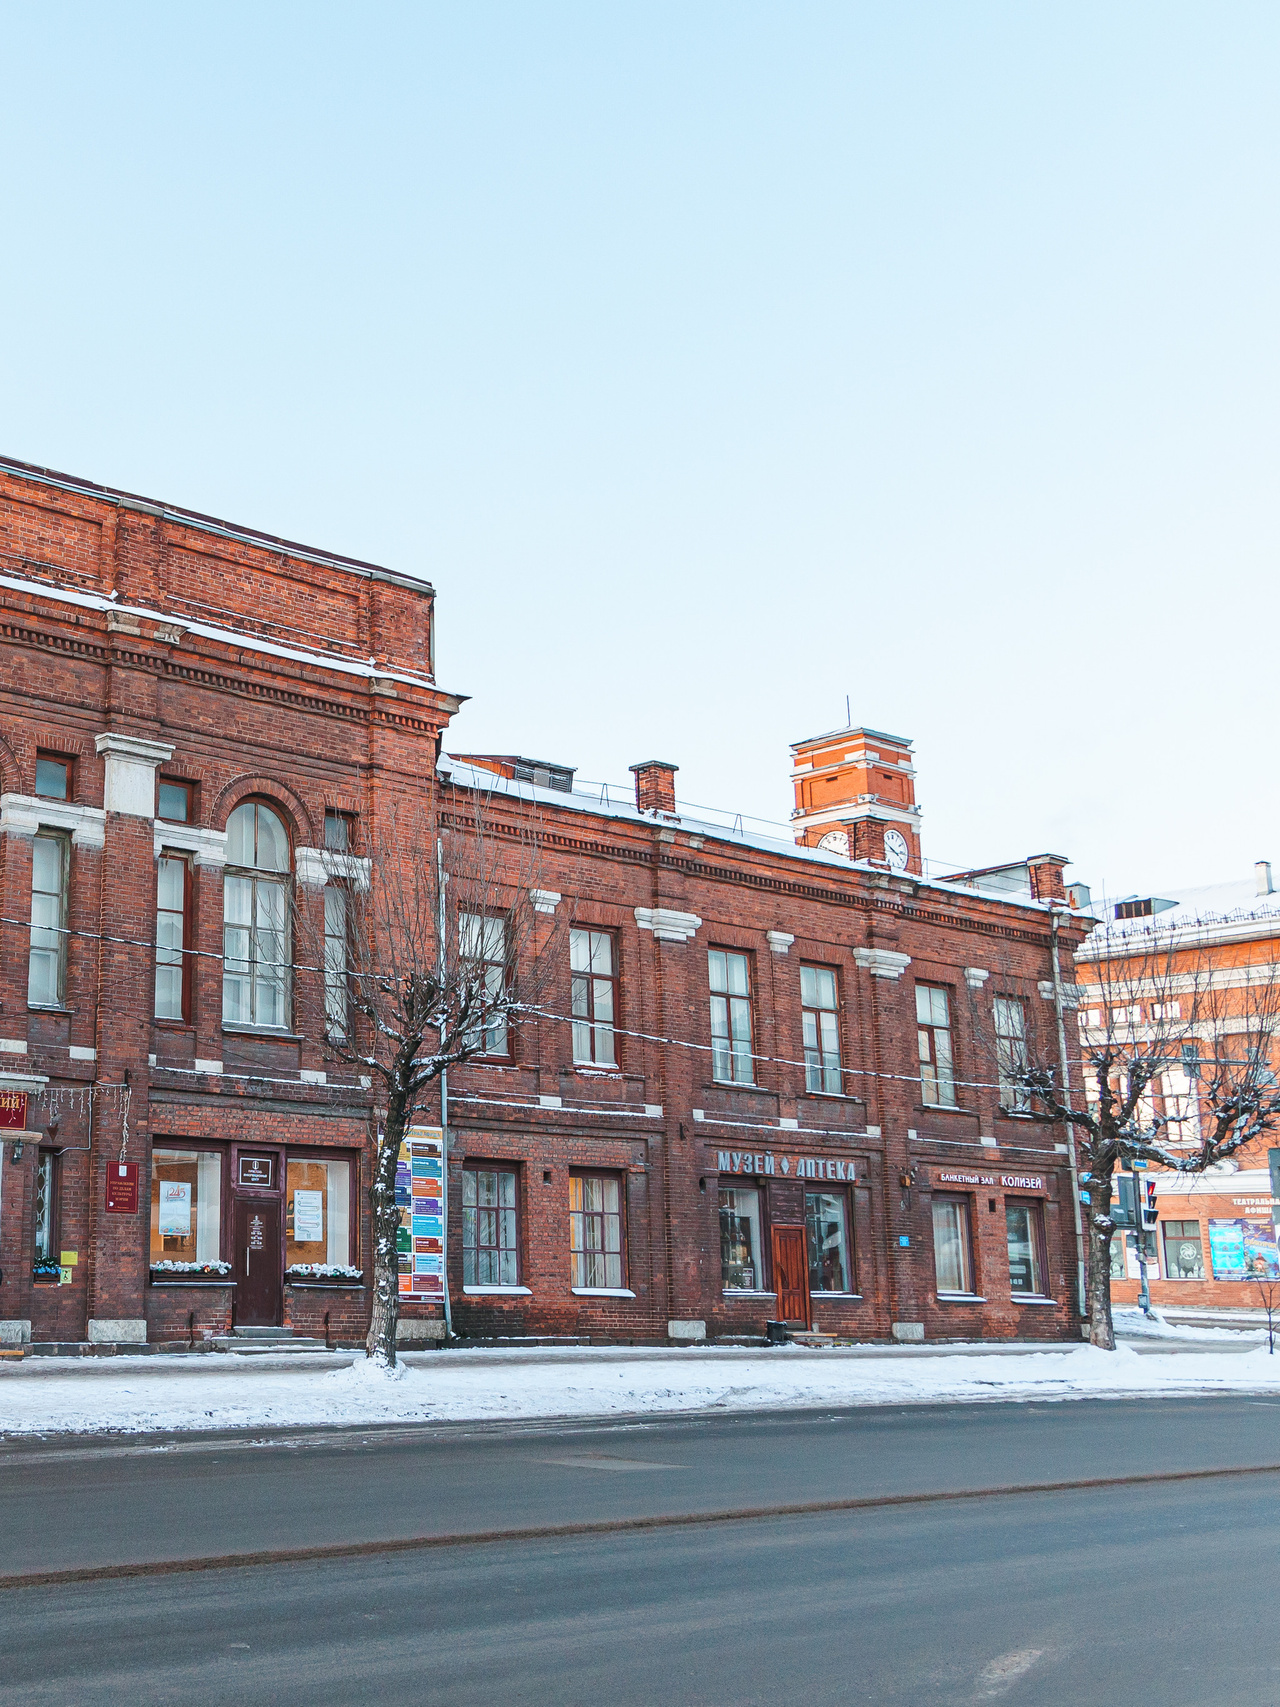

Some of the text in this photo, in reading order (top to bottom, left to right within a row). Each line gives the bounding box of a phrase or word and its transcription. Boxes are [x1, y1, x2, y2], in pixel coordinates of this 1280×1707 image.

[718, 1150, 856, 1181] МУЗЕЙ АПТЕКА
[940, 1173, 1042, 1189] БАНКЕТНЫЙ ЗАЛ КОЛИЗЕЙ
